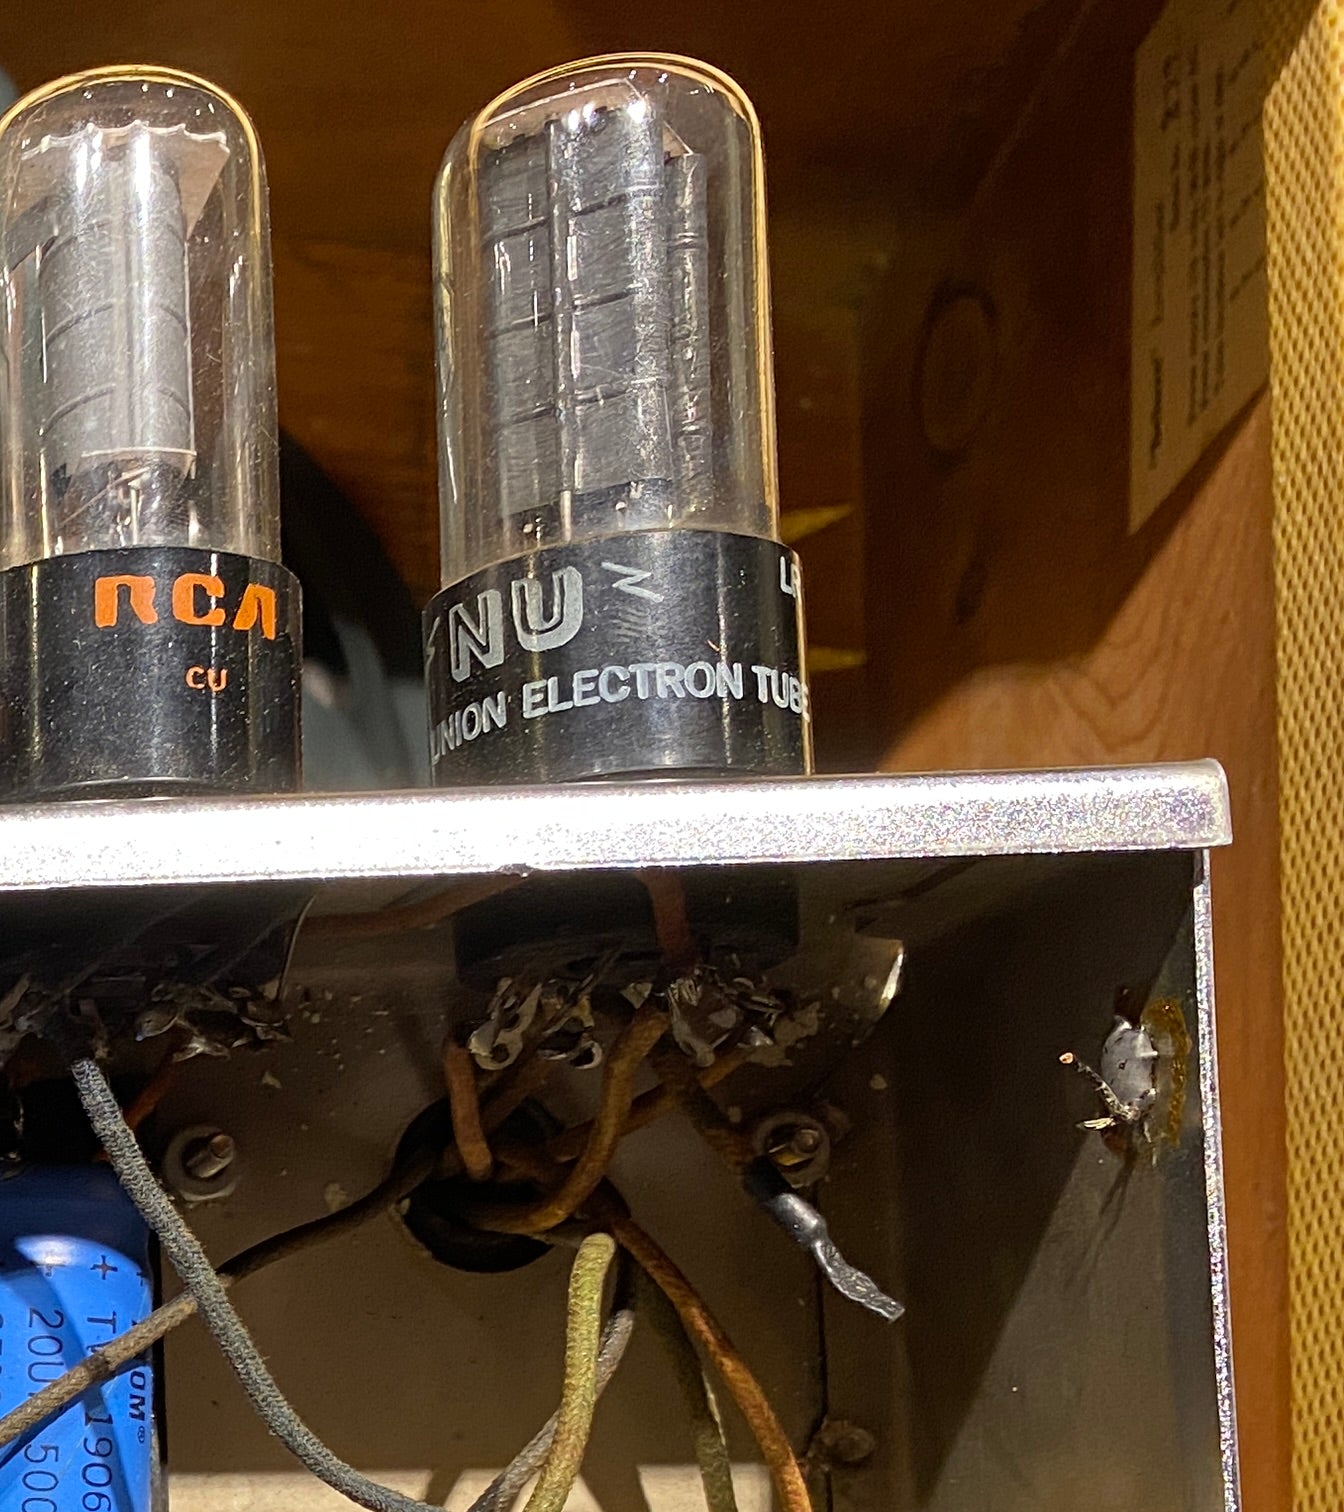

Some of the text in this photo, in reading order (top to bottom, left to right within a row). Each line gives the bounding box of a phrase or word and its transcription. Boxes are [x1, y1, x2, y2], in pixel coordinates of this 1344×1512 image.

[95, 572, 277, 641] RCA
[185, 665, 229, 692] CU
[522, 661, 744, 719] ELECTRON
[27, 1308, 64, 1402] 20U
